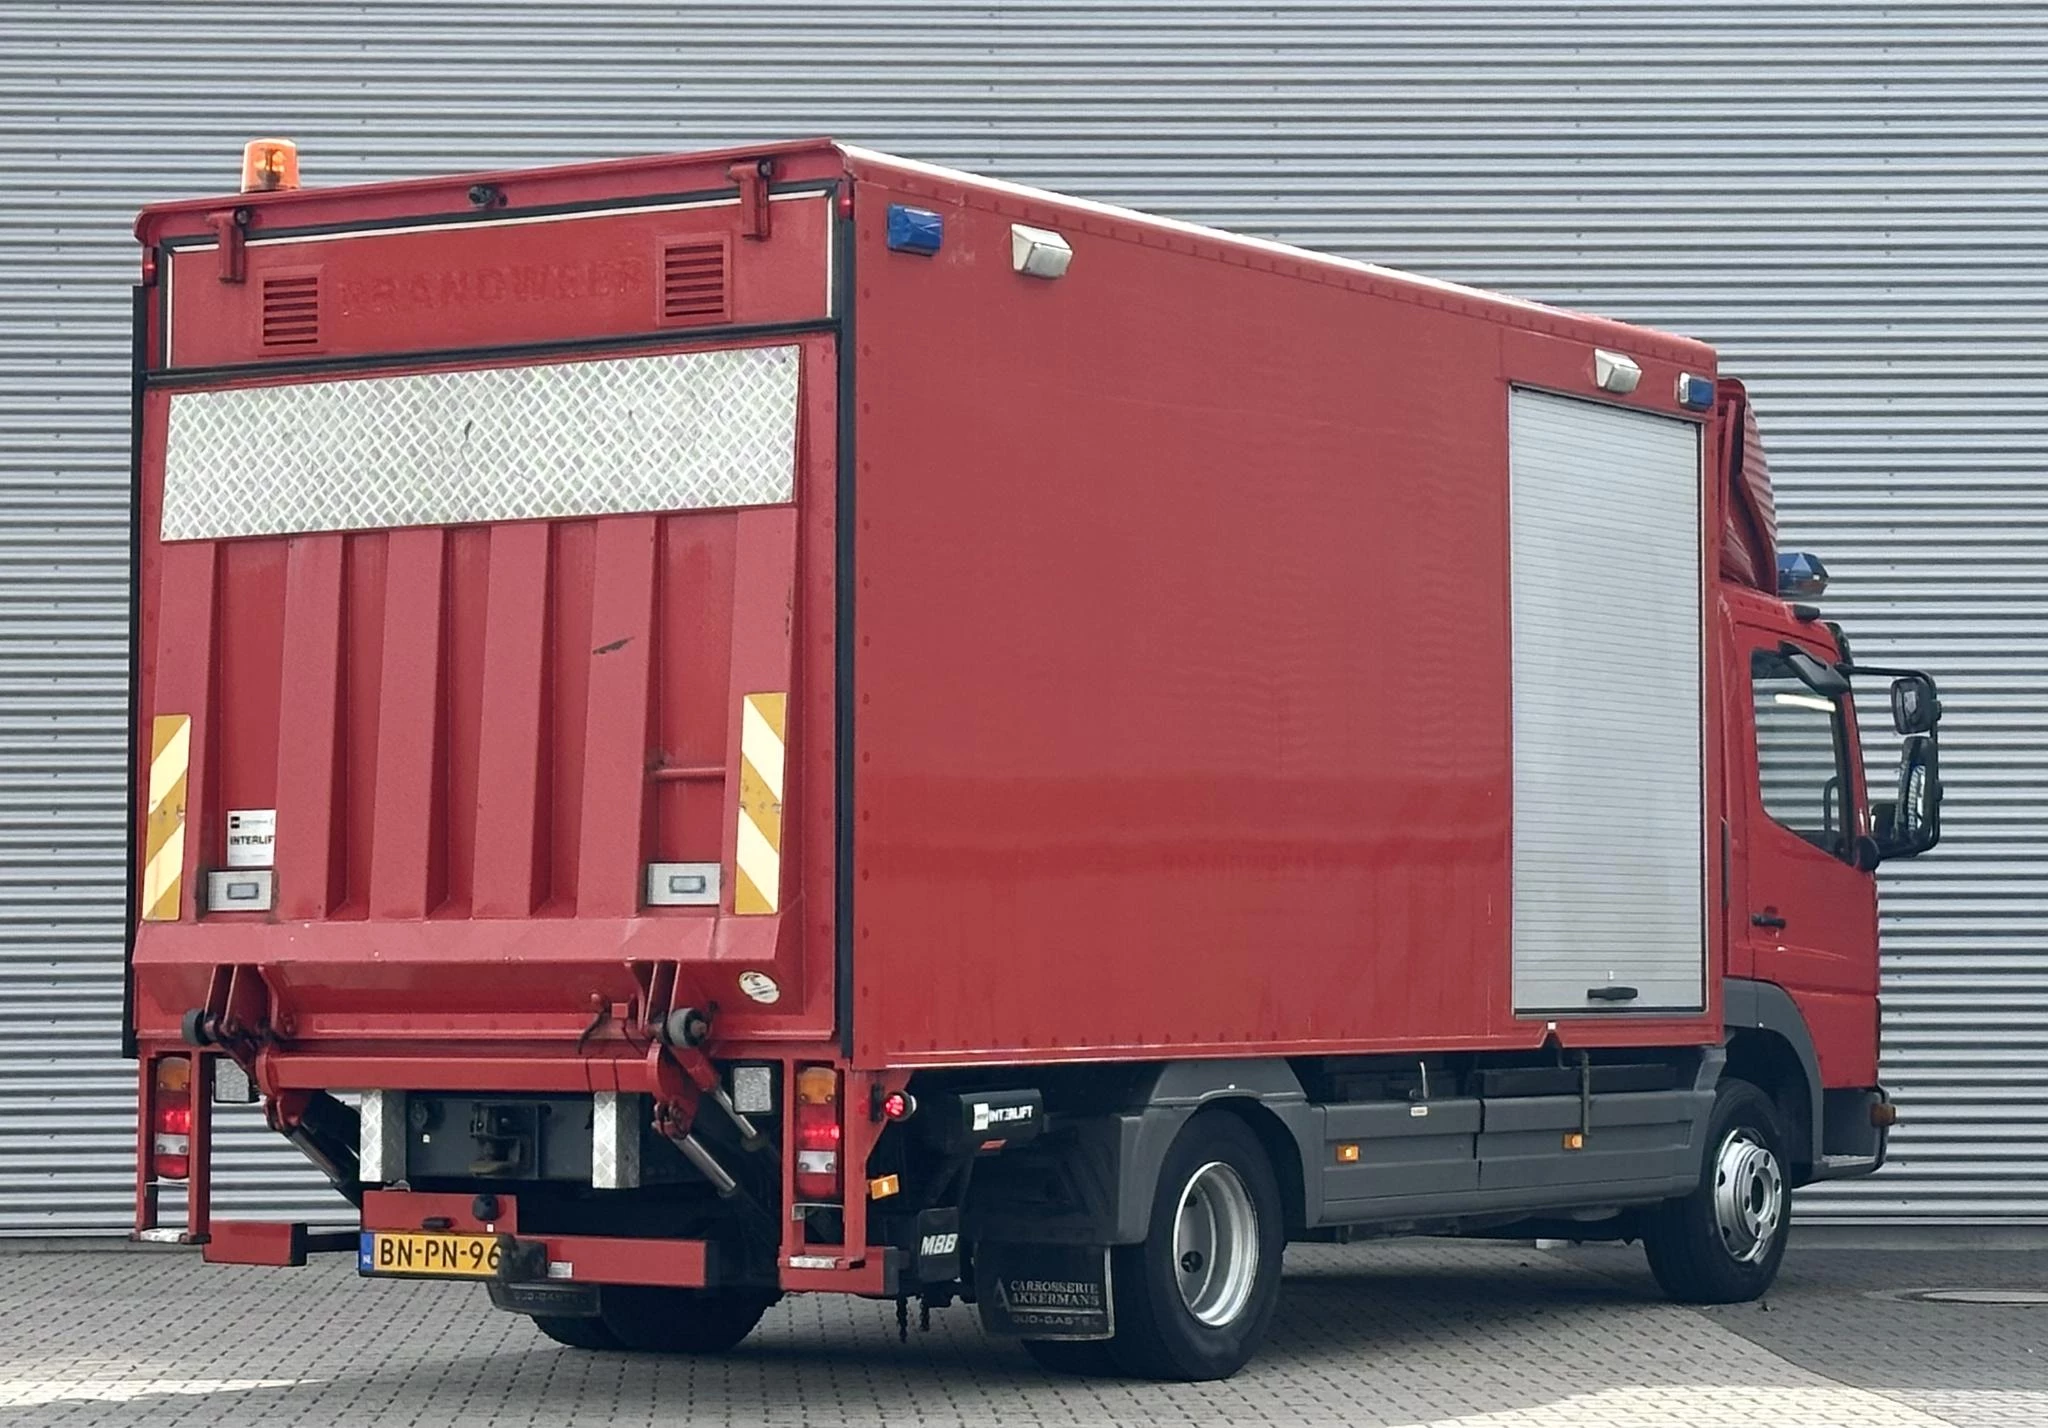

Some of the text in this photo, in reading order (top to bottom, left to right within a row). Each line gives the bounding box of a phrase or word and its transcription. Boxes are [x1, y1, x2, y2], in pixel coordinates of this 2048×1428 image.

[230, 835, 275, 846] INTERLIF
[380, 1238, 502, 1269] BN-PN-96
[920, 1233, 958, 1256] MBB
[1010, 1279, 1099, 1294] CARROSSERIE
